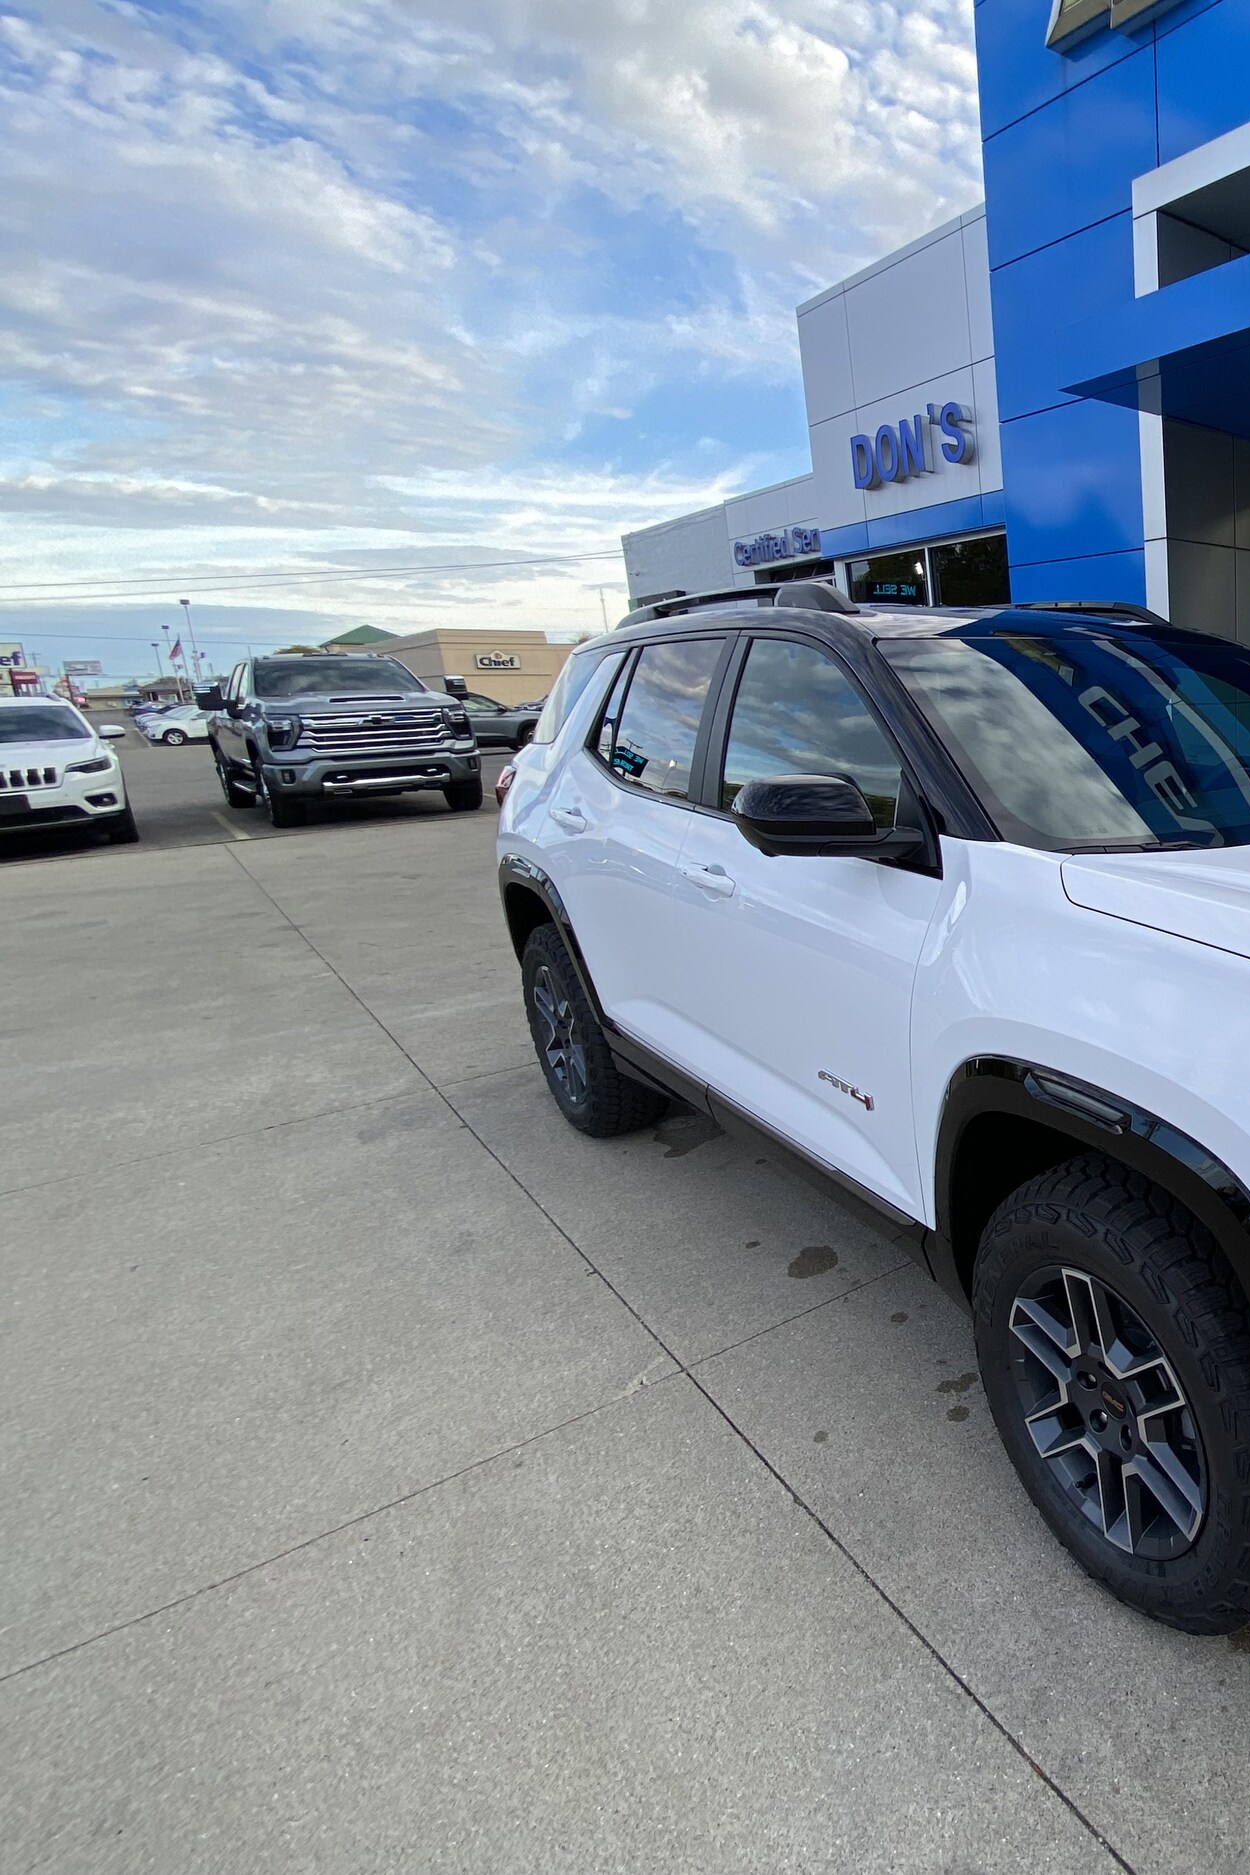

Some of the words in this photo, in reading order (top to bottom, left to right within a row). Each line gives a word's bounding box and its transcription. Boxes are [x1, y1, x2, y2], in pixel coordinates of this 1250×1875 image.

[850, 402, 971, 490] DON'S
[734, 529, 789, 566] Certified
[479, 656, 515, 667] Chief
